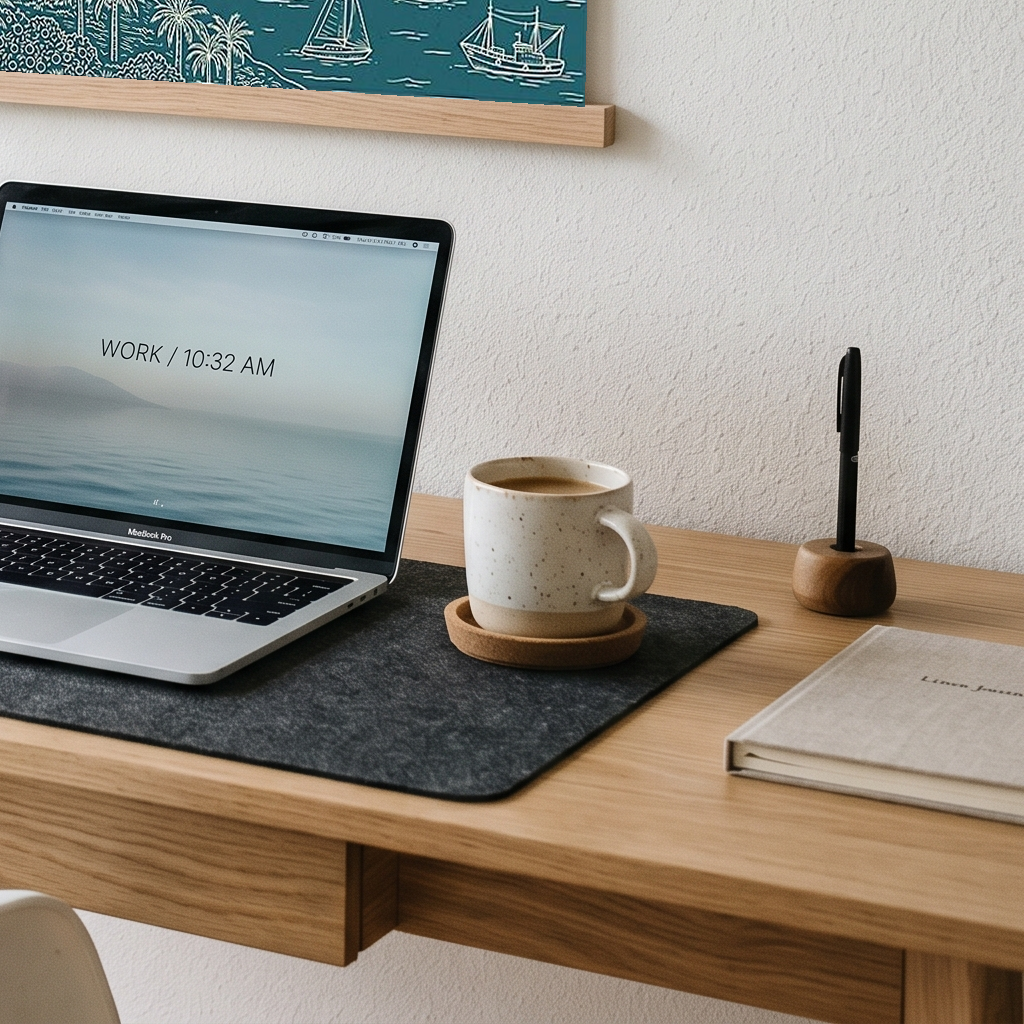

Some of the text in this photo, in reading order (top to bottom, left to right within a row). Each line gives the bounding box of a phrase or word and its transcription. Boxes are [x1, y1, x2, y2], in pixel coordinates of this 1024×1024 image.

[101, 338, 275, 378] WORK / 10:32 AM
[160, 532, 172, 541] Pro
